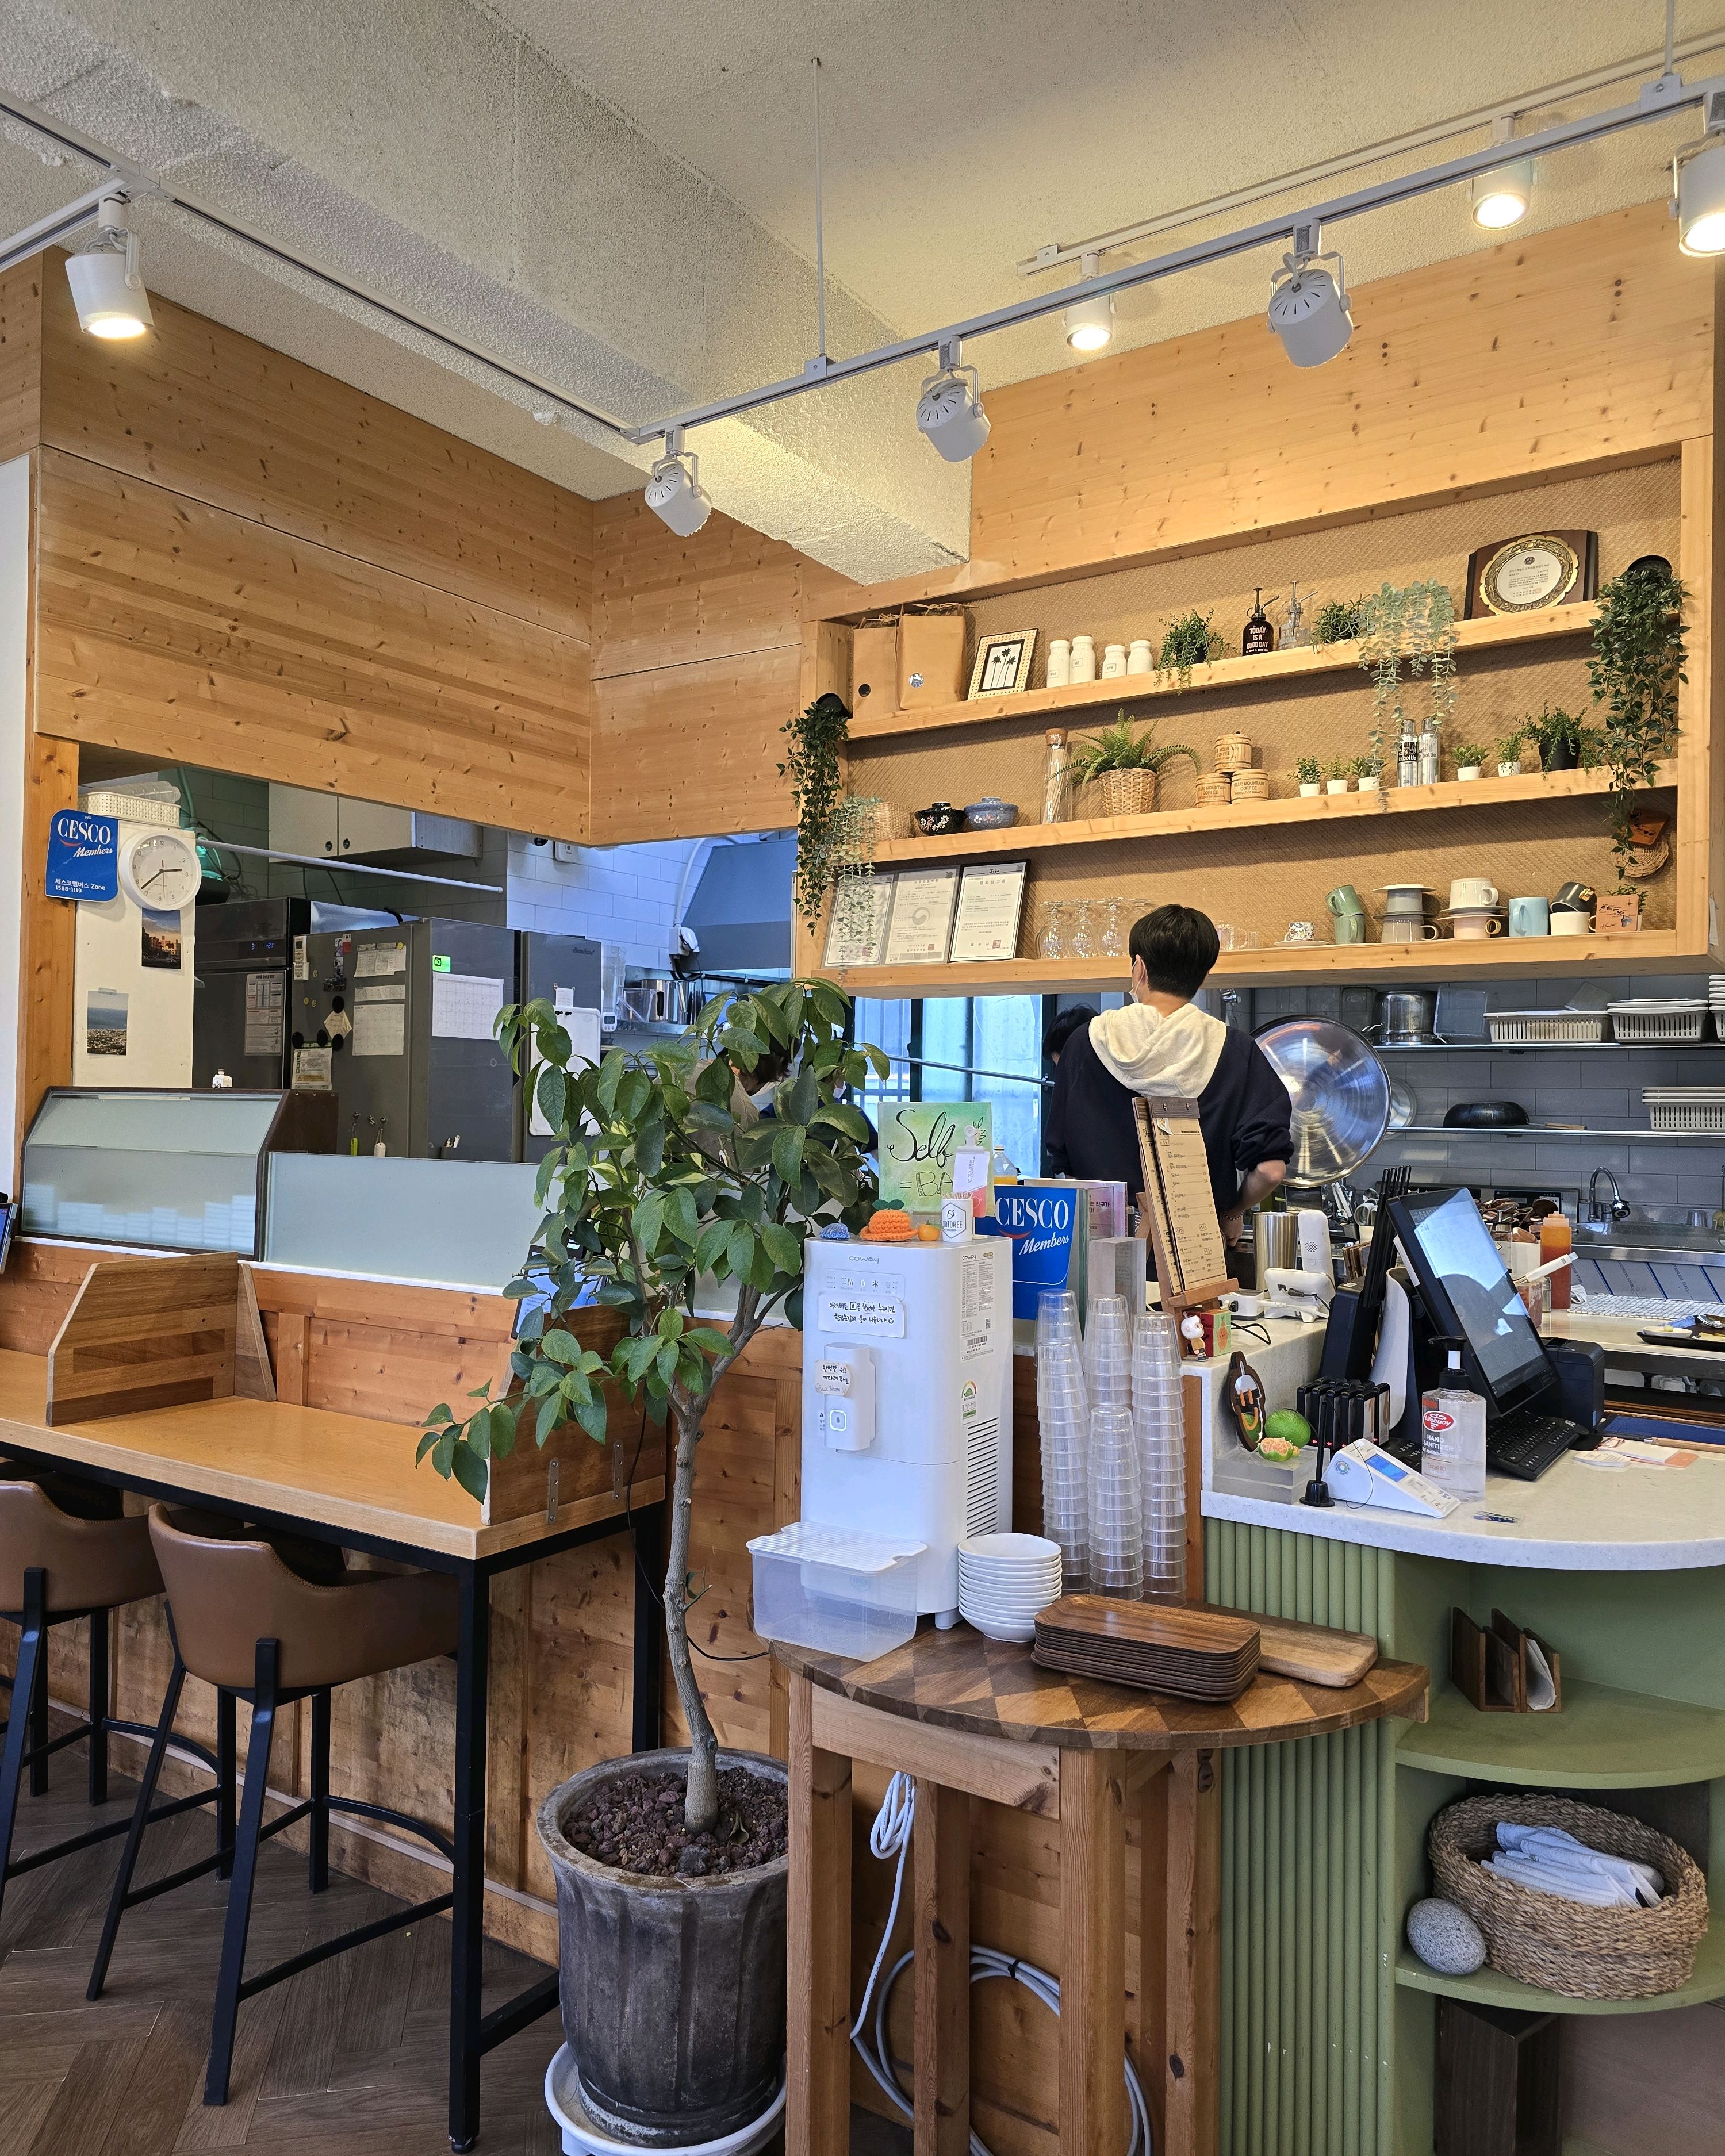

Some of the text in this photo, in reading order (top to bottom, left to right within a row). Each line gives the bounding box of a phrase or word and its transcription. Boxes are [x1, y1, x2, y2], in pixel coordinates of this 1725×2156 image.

[1249, 626, 1266, 634] TODAY
[57, 818, 111, 845] CESCO
[73, 845, 113, 858] Members
[55, 885, 82, 893] 1588-1119
[886, 1109, 956, 1168] Self
[915, 1171, 953, 1197] BA
[995, 1197, 1069, 1230] CESCO
[942, 1221, 963, 1229] DOTOREE
[1018, 1232, 1070, 1256] Members
[849, 1256, 879, 1264] coway
[829, 1302, 849, 1310] 아래버튼
[822, 1364, 837, 1372] 한번만
[1425, 1415, 1452, 1426] Lifebuoy
[1427, 1434, 1444, 1443] HAND
[1423, 1439, 1454, 1452] SANITIZER
